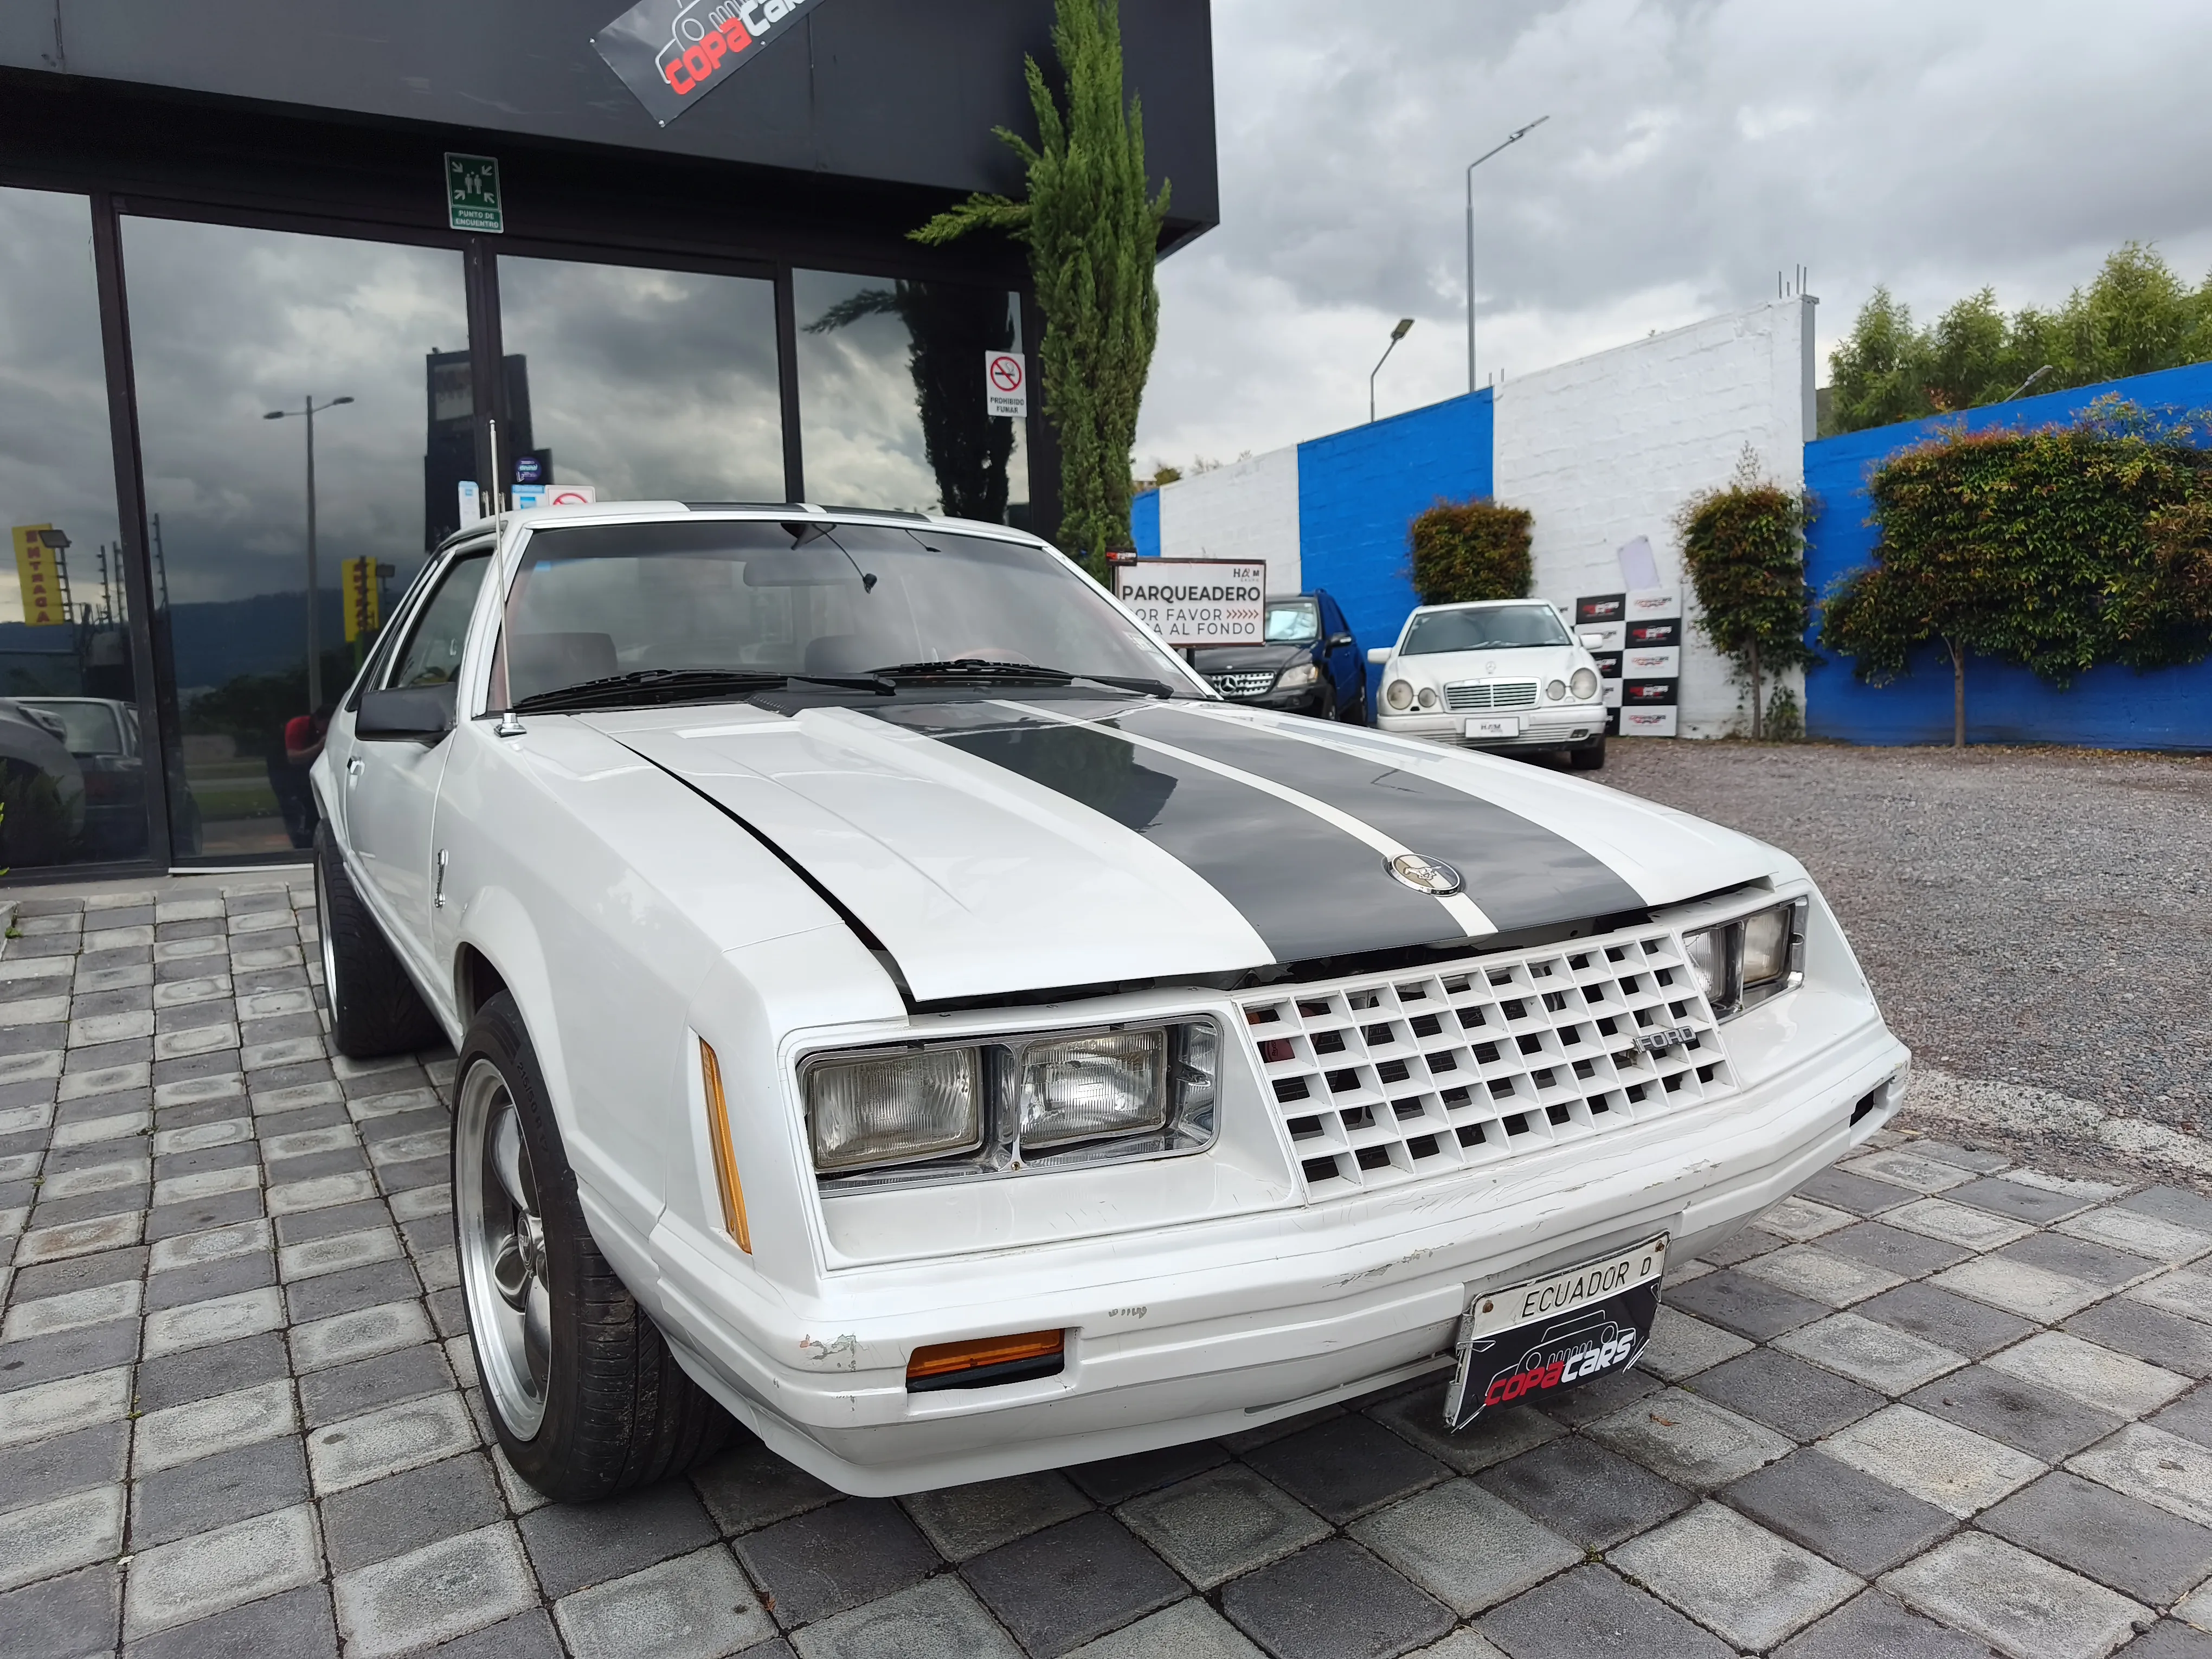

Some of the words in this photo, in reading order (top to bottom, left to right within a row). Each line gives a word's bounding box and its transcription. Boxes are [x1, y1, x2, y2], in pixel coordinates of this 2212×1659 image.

[458, 210, 483, 218] PUNTO
[455, 218, 499, 228] ENCUENTRO
[990, 396, 1025, 406] PROHIBIDO
[996, 406, 1019, 414] FUMAR
[1122, 586, 1261, 603] PARQUEADERO
[1129, 608, 1159, 621] OR
[1166, 608, 1222, 621] FAVOR
[1169, 623, 1191, 635] AL
[1197, 623, 1256, 635] FONDO
[1636, 1025, 1696, 1053] FORD
[517, 1061, 538, 1114] 215/50
[1521, 1261, 1630, 1318] ECUADOR
